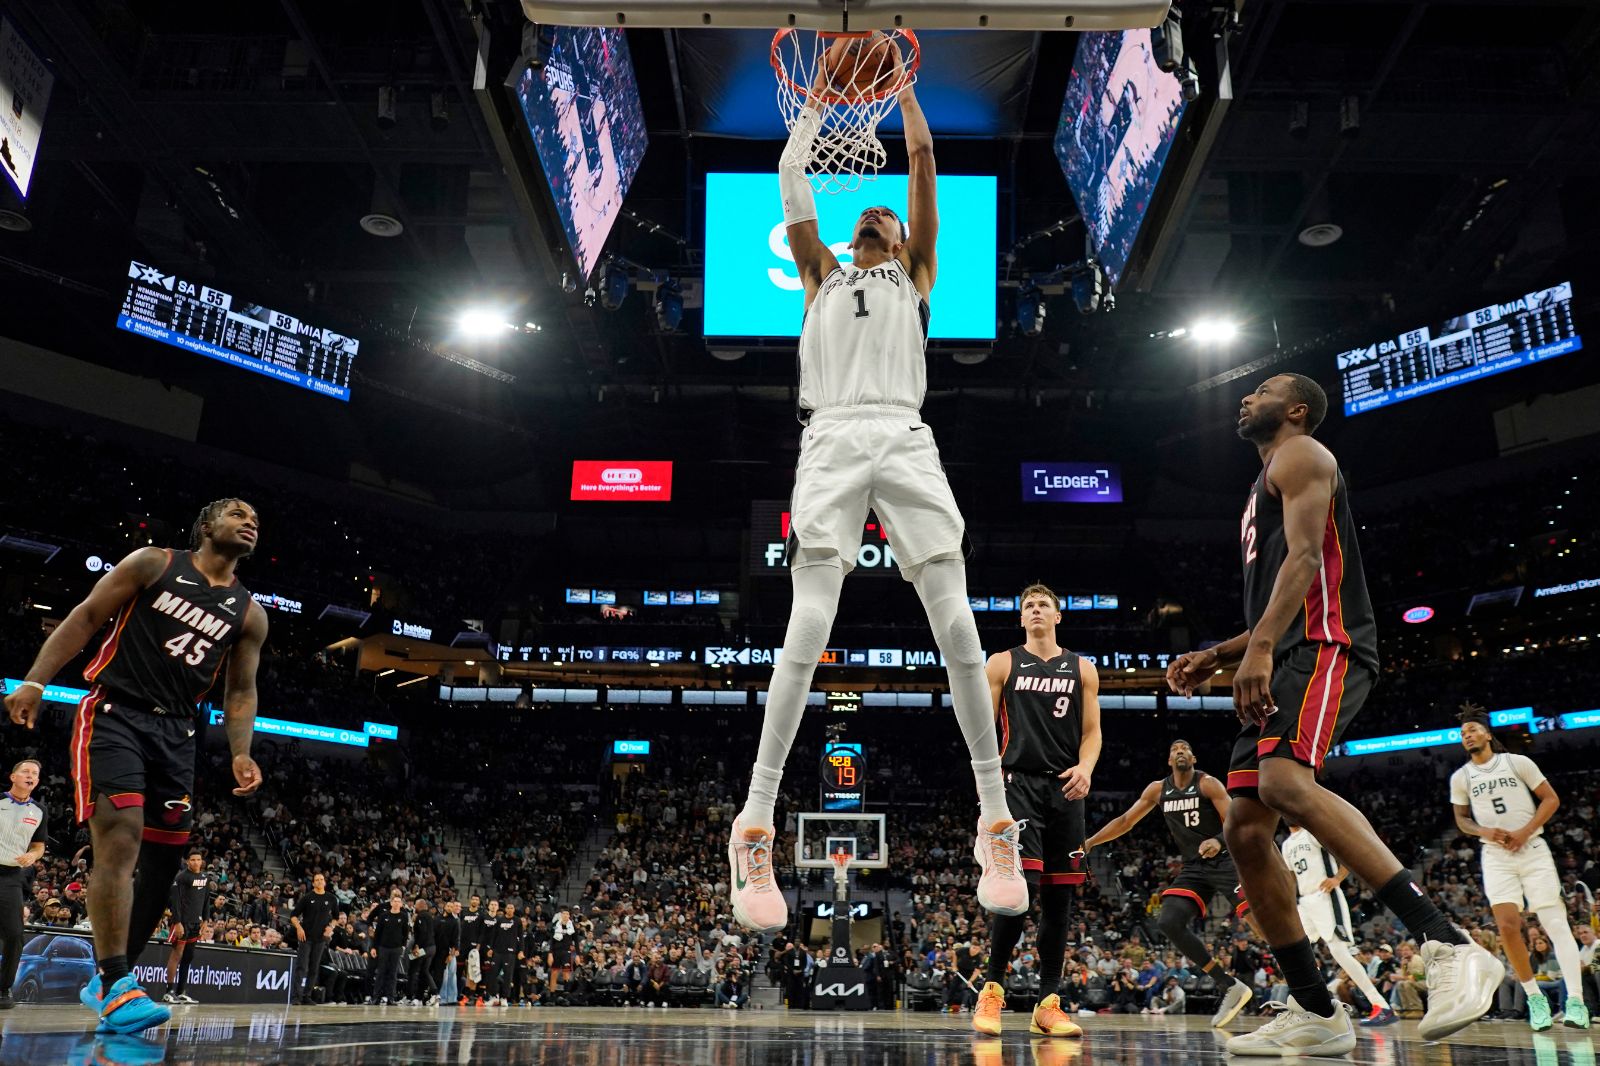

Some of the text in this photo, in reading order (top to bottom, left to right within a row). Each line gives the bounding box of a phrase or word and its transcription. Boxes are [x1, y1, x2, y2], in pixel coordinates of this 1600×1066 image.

[177, 279, 196, 296] SA
[206, 289, 224, 306] 55
[854, 288, 869, 318] 1
[1498, 297, 1526, 316] MIA
[275, 314, 292, 330] 58
[1475, 308, 1492, 324] 58
[134, 321, 169, 338] Methodist
[297, 322, 322, 339] MIA
[1378, 338, 1396, 354] SA
[1406, 330, 1422, 346] 55
[184, 338, 229, 360] neighborhood
[242, 358, 263, 370] across
[263, 364, 275, 374] San
[275, 368, 300, 382] Antonio
[314, 380, 343, 395] Methodist
[1044, 476, 1099, 488] LEDGER
[1534, 583, 1578, 598] Americus
[278, 598, 302, 610] STAR
[152, 591, 232, 640] MIAMI
[403, 622, 432, 636] beldon
[165, 632, 212, 666] 45
[578, 650, 593, 659] TO
[612, 650, 639, 660] FG%
[667, 651, 682, 660] PF
[752, 650, 772, 663] SA
[879, 653, 892, 663] 58
[905, 652, 936, 664] MIA
[1014, 676, 1076, 693] MIAMI
[1053, 696, 1070, 718] 9
[349, 735, 365, 743] Frost
[829, 756, 851, 767] 42.8
[838, 767, 856, 786] 19
[1472, 778, 1518, 797] SPURS
[1164, 797, 1200, 813] MIAMI
[1492, 797, 1507, 814] 5
[1183, 811, 1200, 827] 13
[1294, 858, 1307, 875] 30
[193, 878, 207, 887] HEAT
[205, 965, 242, 990] Inspires
